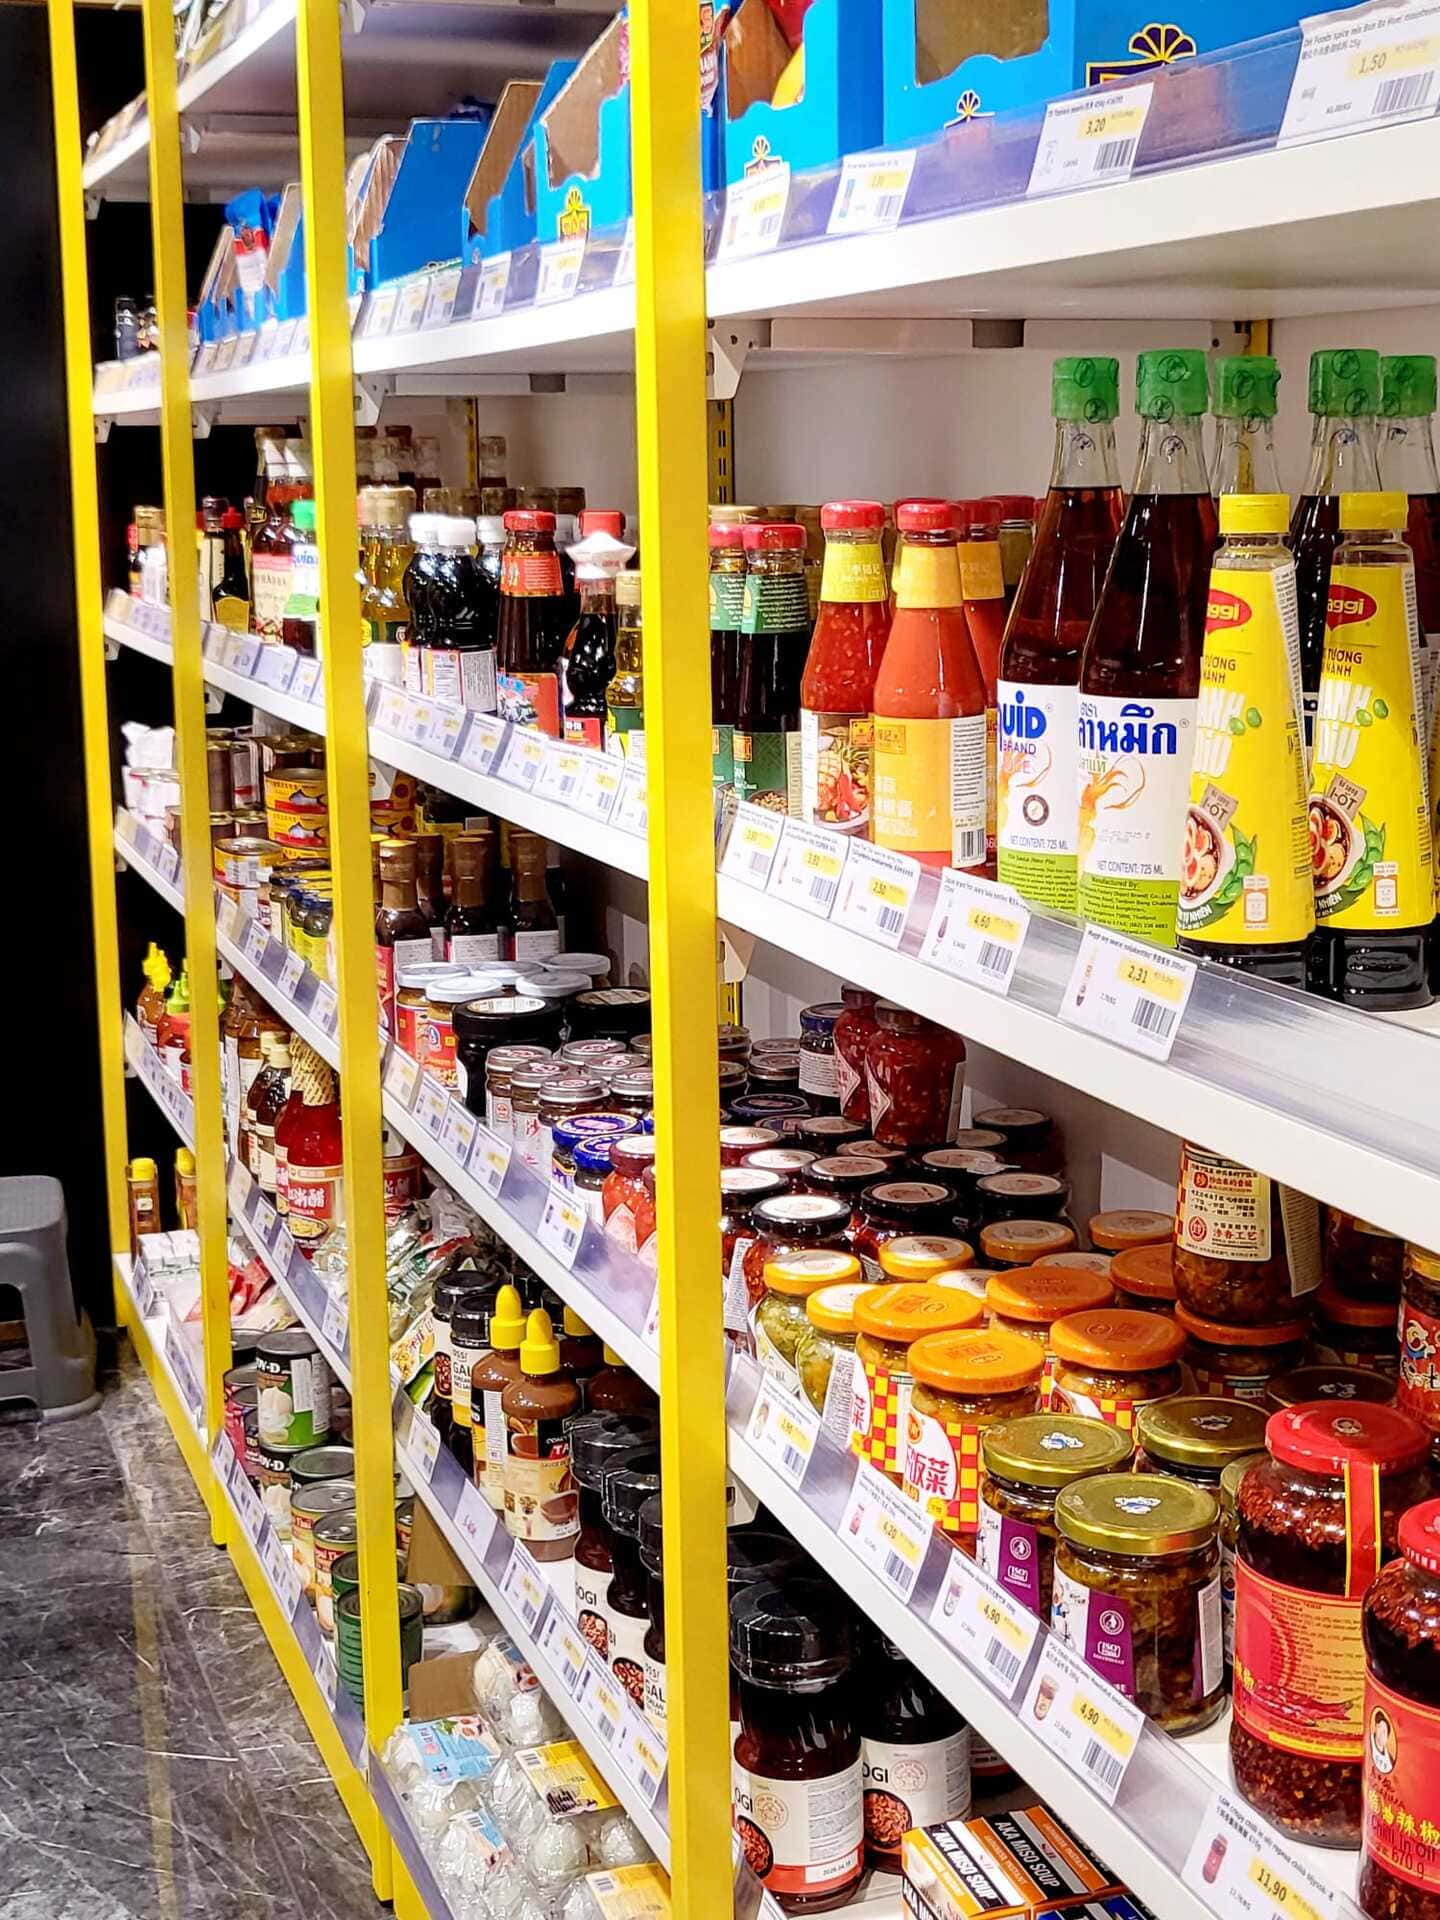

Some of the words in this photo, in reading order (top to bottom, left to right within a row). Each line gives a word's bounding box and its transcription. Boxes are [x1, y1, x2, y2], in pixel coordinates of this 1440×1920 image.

[1153, 865, 1165, 876] ML
[1127, 964, 1149, 984] 2,31
[983, 1604, 1001, 1625] 4,90
[1080, 1703, 1099, 1726] 4,90
[995, 1821, 1023, 1841] AKA
[1010, 1840, 1037, 1863] MISO
[1030, 1862, 1061, 1888] SOUP
[1392, 1847, 1413, 1870] 670
[967, 1873, 999, 1900] SOUP
[1256, 1867, 1288, 1902] 11,90
